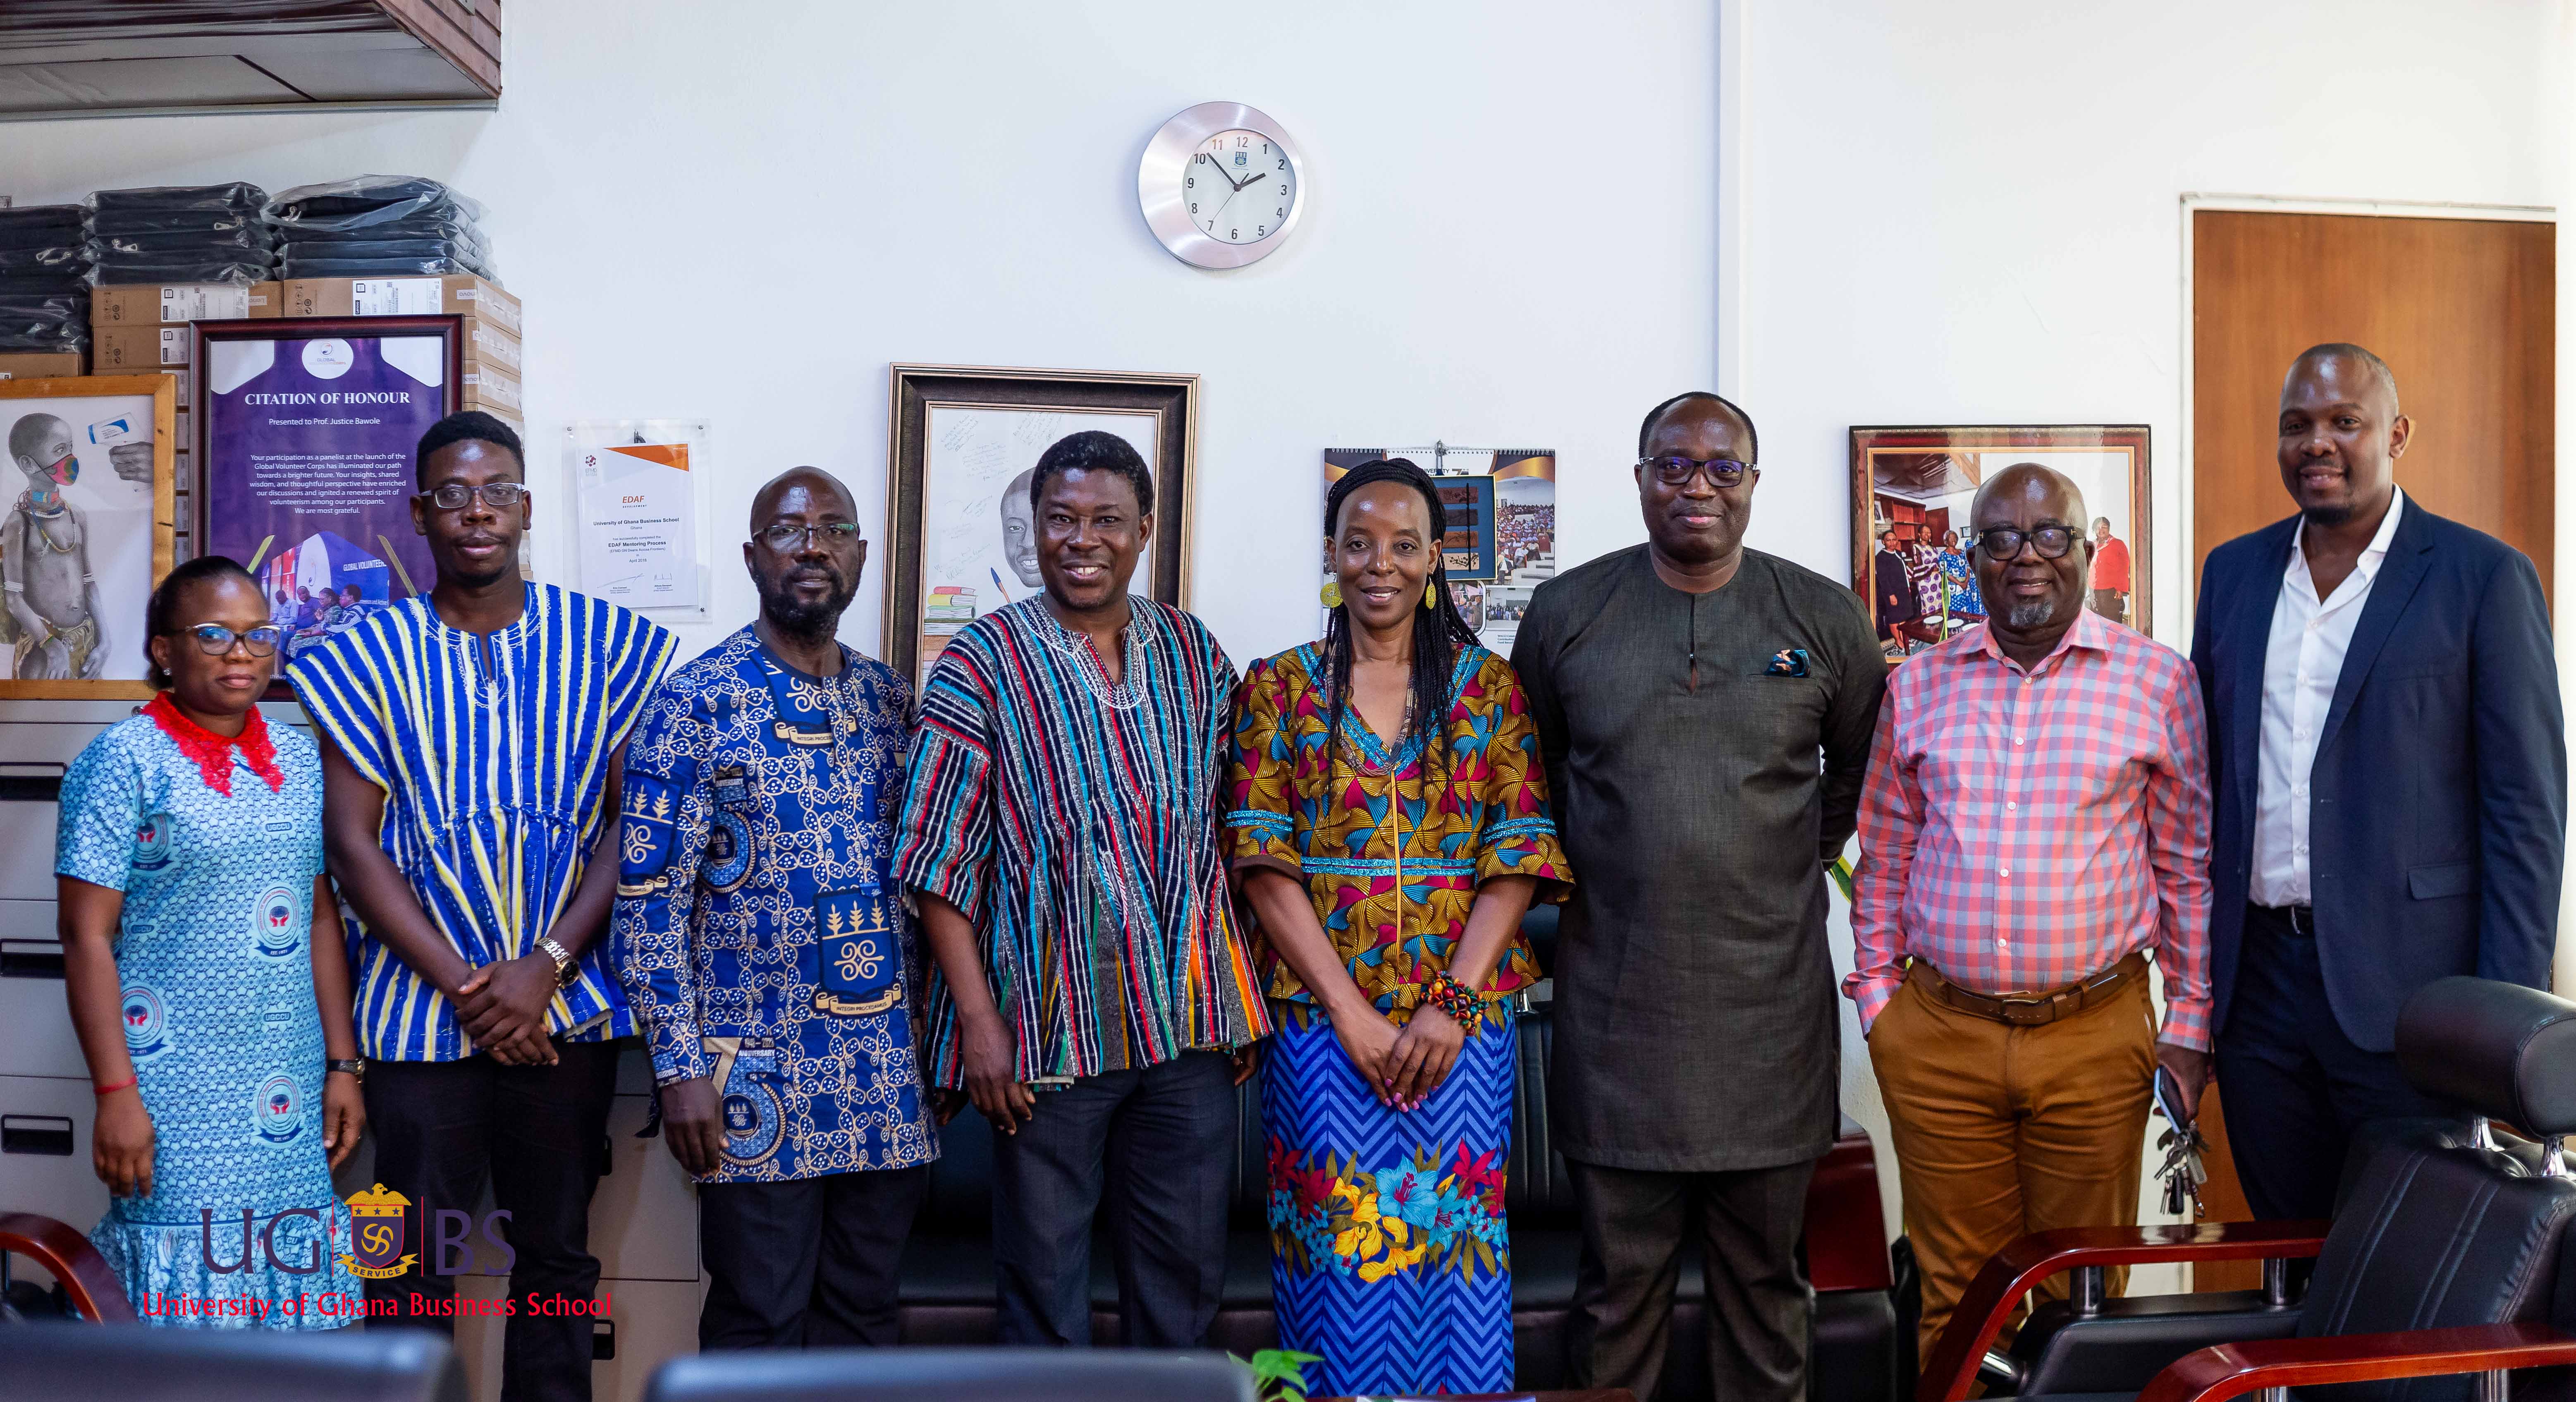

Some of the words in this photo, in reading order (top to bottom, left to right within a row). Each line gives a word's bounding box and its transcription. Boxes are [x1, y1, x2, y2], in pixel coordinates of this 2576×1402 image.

[1212, 139, 1223, 150] 11
[1237, 136, 1248, 148] 12
[1263, 144, 1267, 154] 1
[1194, 153, 1206, 164] 10
[1278, 159, 1285, 170] 2
[1188, 178, 1194, 189] 9
[1281, 185, 1287, 196] 3
[1192, 203, 1198, 214] 8
[1276, 208, 1283, 218] 4
[1208, 220, 1214, 231] 7
[1258, 225, 1264, 236] 5
[1231, 229, 1238, 239] 6
[245, 393, 316, 404] CITATION
[320, 393, 340, 404] OF
[344, 392, 411, 404] HONOUR
[344, 563, 358, 571] GLOBAL
[855, 1001, 887, 1011] PROCEDAMUS
[265, 1012, 289, 1021] UGCCU
